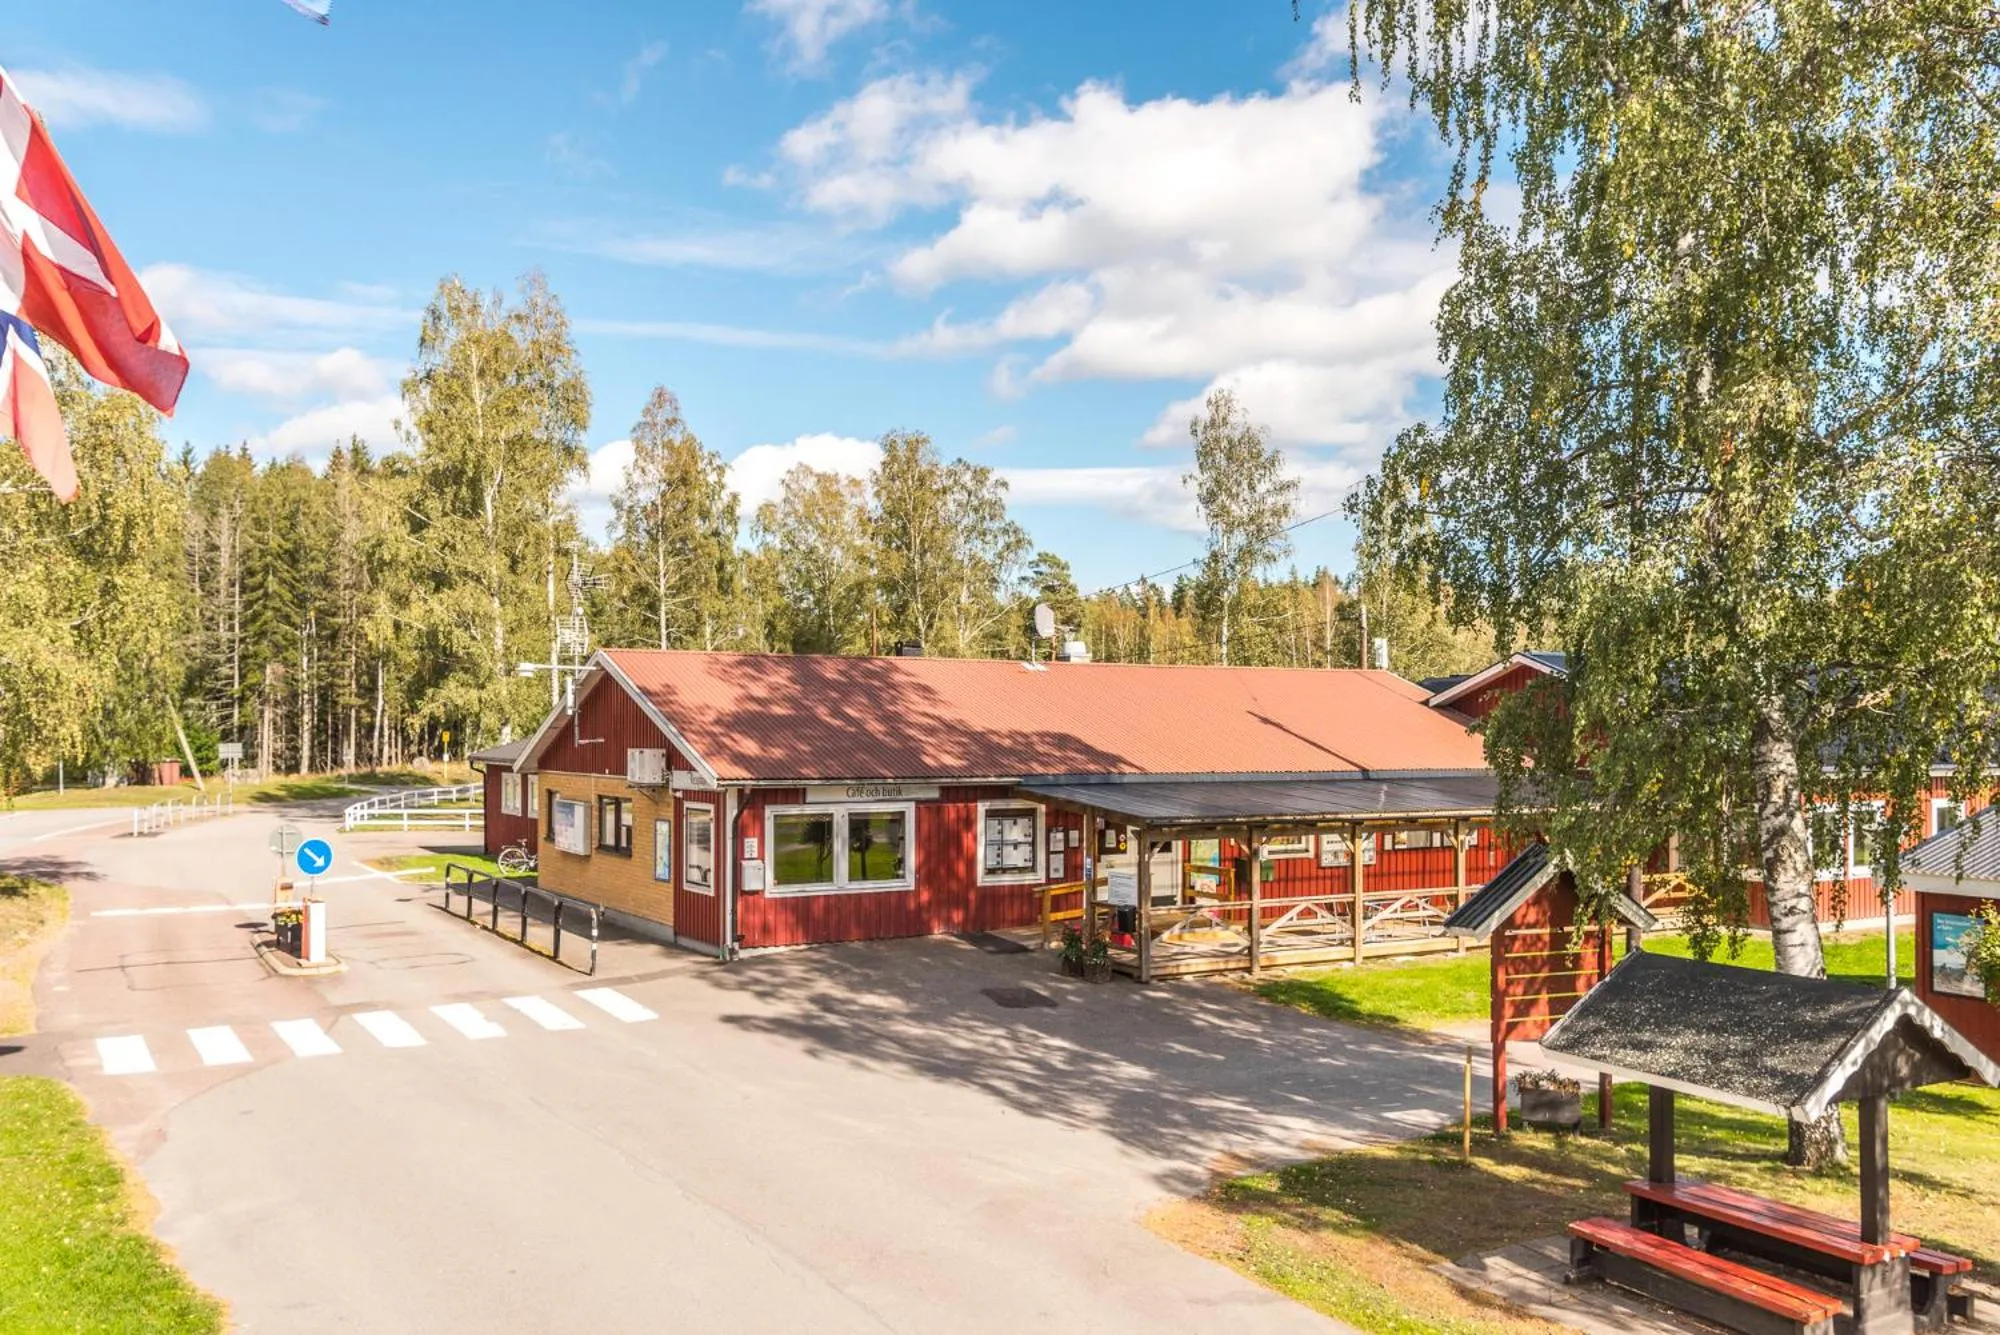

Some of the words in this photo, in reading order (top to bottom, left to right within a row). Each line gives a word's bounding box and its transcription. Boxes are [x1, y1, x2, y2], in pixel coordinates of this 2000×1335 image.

[846, 785, 864, 798] Café
[866, 786, 880, 798] och
[882, 785, 903, 797] butik
